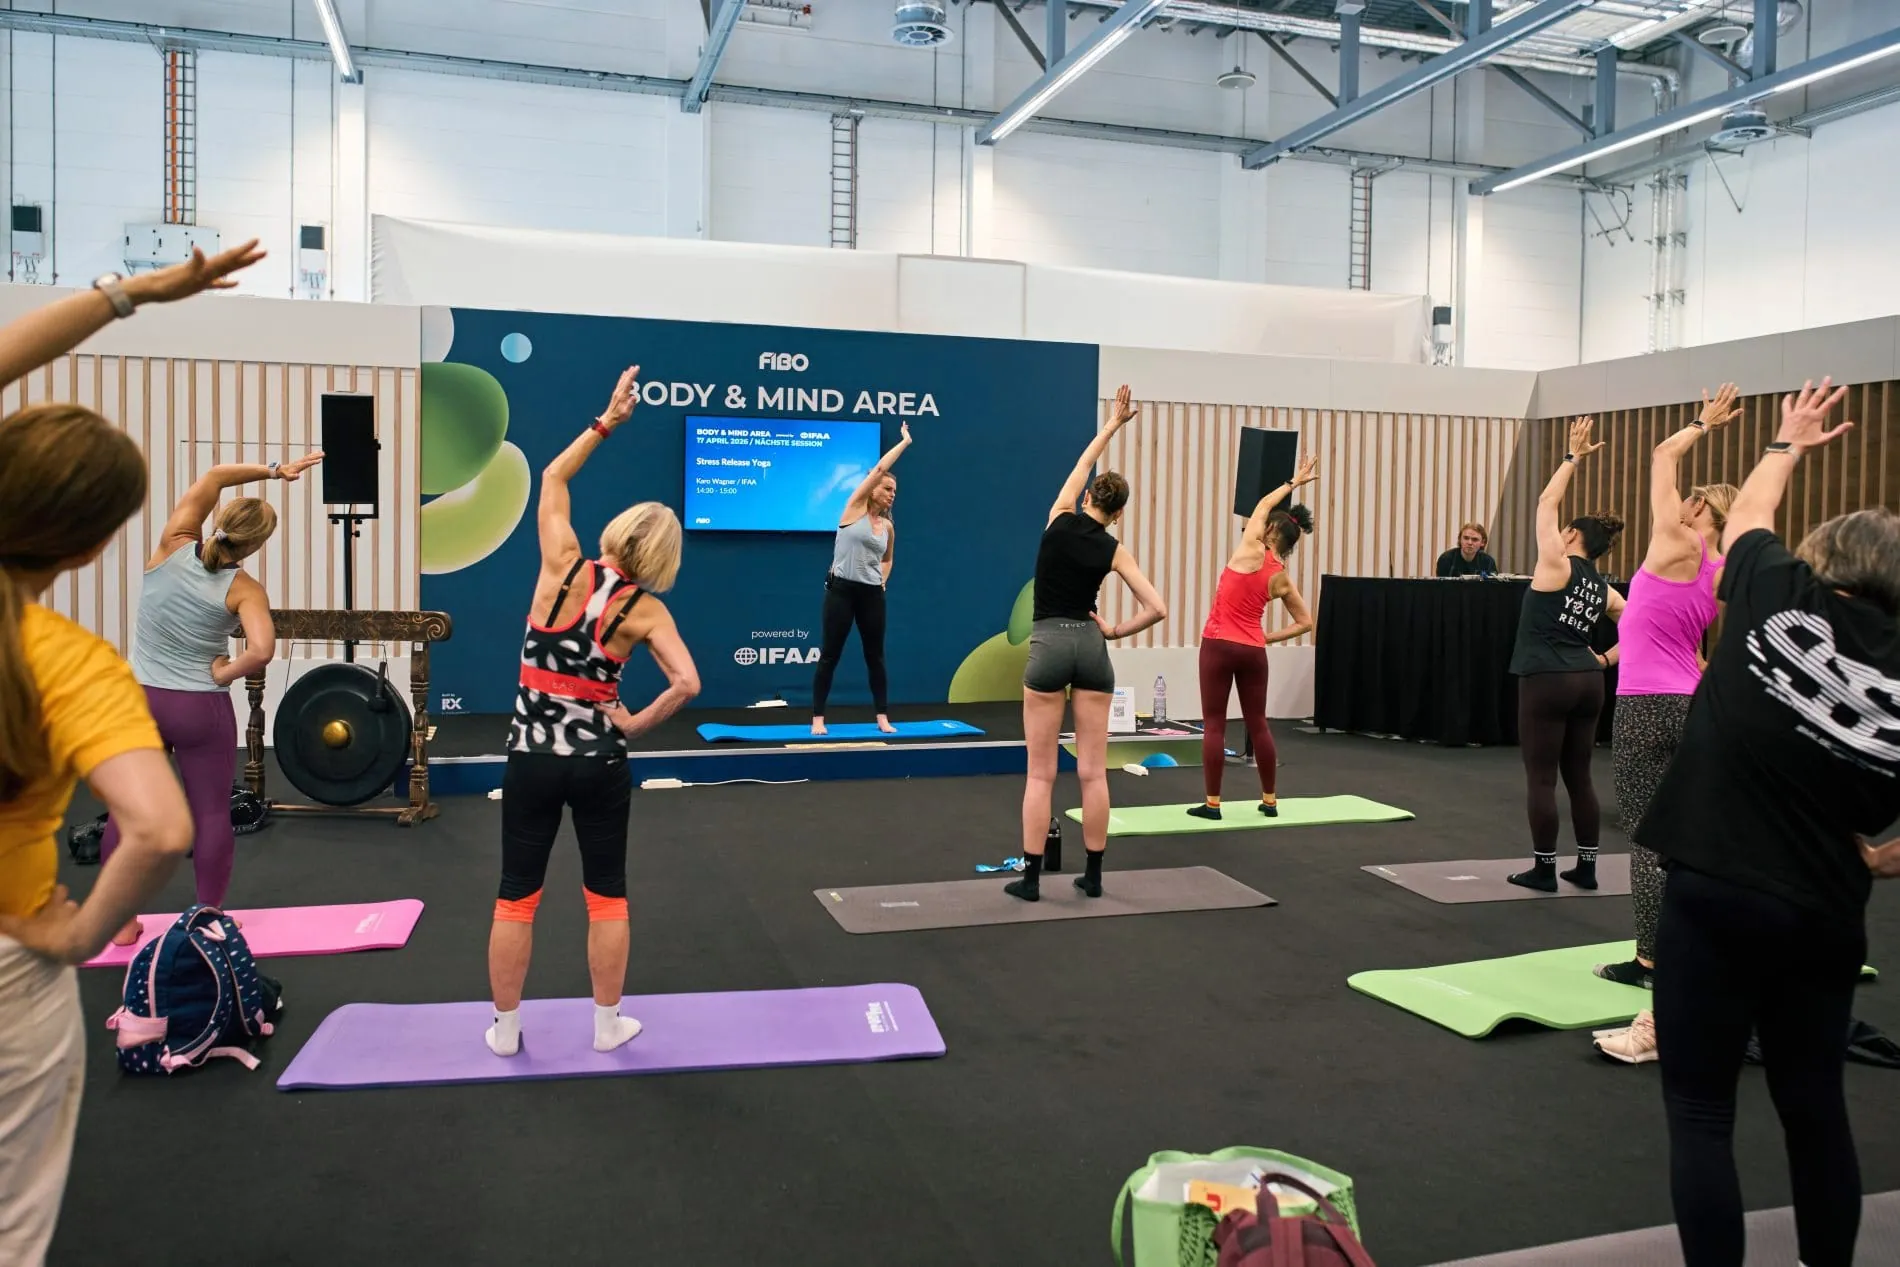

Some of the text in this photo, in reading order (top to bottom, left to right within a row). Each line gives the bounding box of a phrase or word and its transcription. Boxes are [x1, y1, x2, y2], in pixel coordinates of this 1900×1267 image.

[759, 351, 809, 372] FIBO
[724, 384, 746, 410] &
[758, 386, 844, 413] MIND
[852, 390, 940, 417] AREA
[696, 428, 720, 436] BODY
[728, 429, 749, 437] MIND
[750, 430, 771, 438] AREA
[705, 437, 729, 445] APRIL
[754, 438, 790, 446] NÄCHSTE
[791, 439, 823, 447] SESSION
[696, 457, 772, 468] Stress Release Yoga
[711, 478, 735, 486] Wagner
[741, 478, 757, 486] IFAA
[719, 487, 738, 495] 15:00
[1581, 577, 1599, 593] EAT
[751, 629, 810, 640] powered by
[759, 647, 821, 665] IFAA
